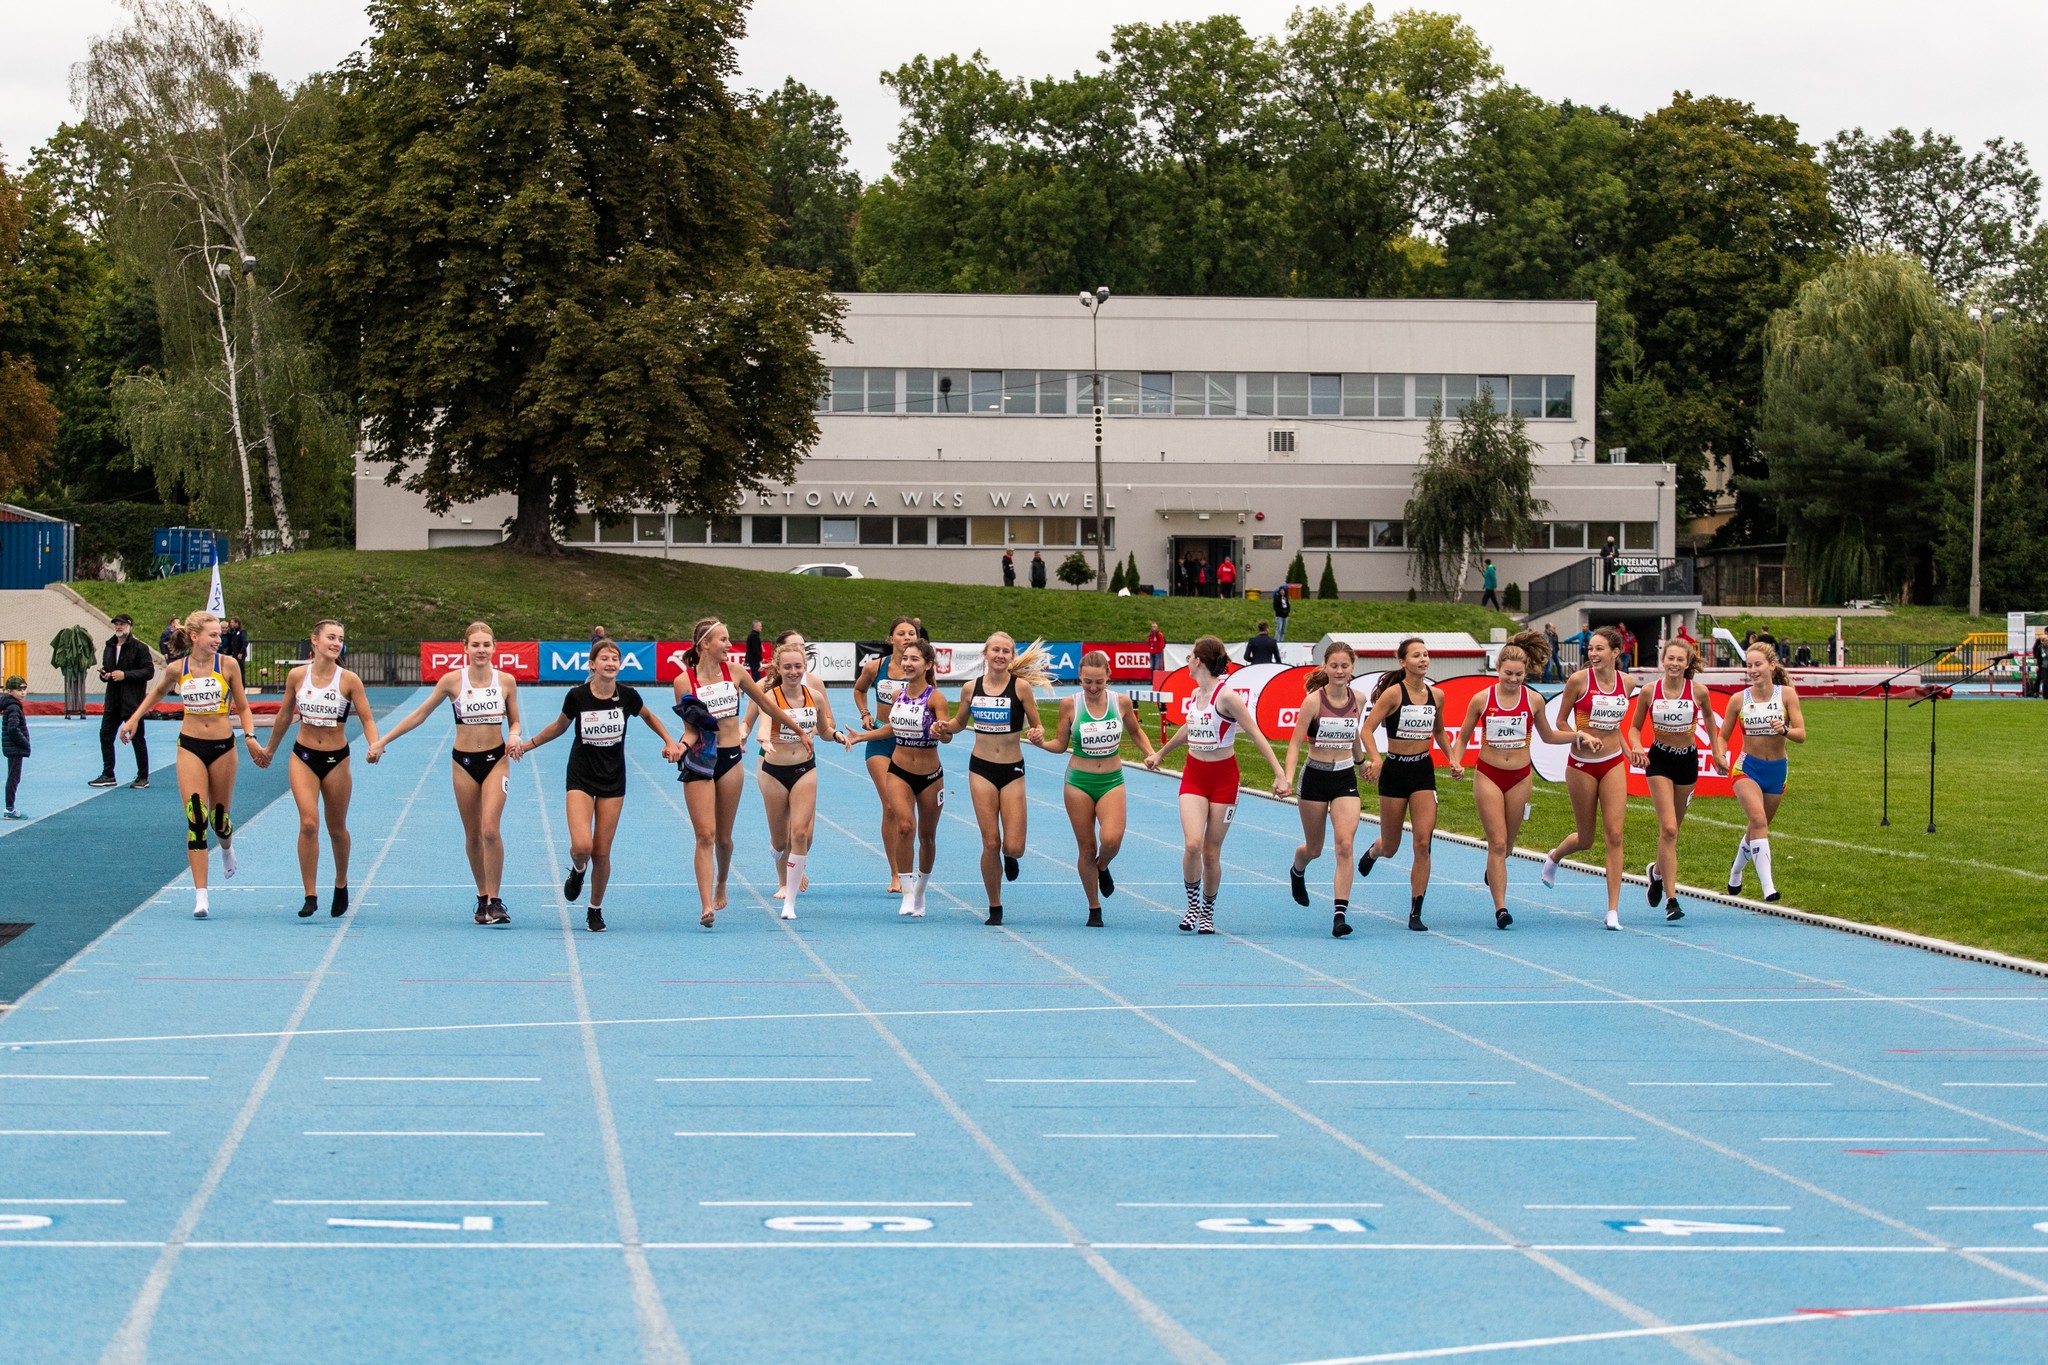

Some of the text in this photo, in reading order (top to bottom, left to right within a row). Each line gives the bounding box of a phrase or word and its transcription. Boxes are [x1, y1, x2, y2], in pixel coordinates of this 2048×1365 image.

[901, 491, 963, 507] WKS
[989, 491, 1116, 508] WAWEL
[1614, 558, 1658, 567] STRZELNICA
[432, 653, 528, 669] PZL.PL
[552, 652, 643, 670] MZA
[822, 656, 852, 670] Okęcie
[205, 678, 216, 687] 22
[724, 682, 730, 691] 7
[183, 691, 221, 701] PIETRZYK
[324, 692, 336, 701] 40
[486, 688, 497, 697] 39
[994, 698, 1006, 707] 12
[1616, 697, 1626, 706] 25
[1677, 700, 1689, 709] 24
[300, 703, 338, 715] STASIERSKA
[466, 701, 499, 712] KOKOT
[909, 706, 920, 714] 49
[1422, 706, 1433, 715] 28
[1767, 702, 1778, 711] 41
[607, 710, 619, 720] 10
[804, 708, 814, 717] 16
[972, 711, 1009, 720] WIESZTORT
[1663, 713, 1683, 721] HOC
[890, 716, 919, 727] RUDNIK
[1106, 720, 1117, 730] 23
[1200, 717, 1209, 726] 13
[1344, 719, 1354, 728] 32
[1404, 719, 1433, 728] KOZAN
[1511, 717, 1523, 726] 27
[584, 724, 622, 735] WRÓBEL
[1497, 728, 1516, 737] ŻUK
[1318, 730, 1355, 740] ZAKRZEWSKA
[1668, 746, 1688, 756] PRO
[939, 791, 944, 802] 8
[1226, 809, 1233, 821] 8
